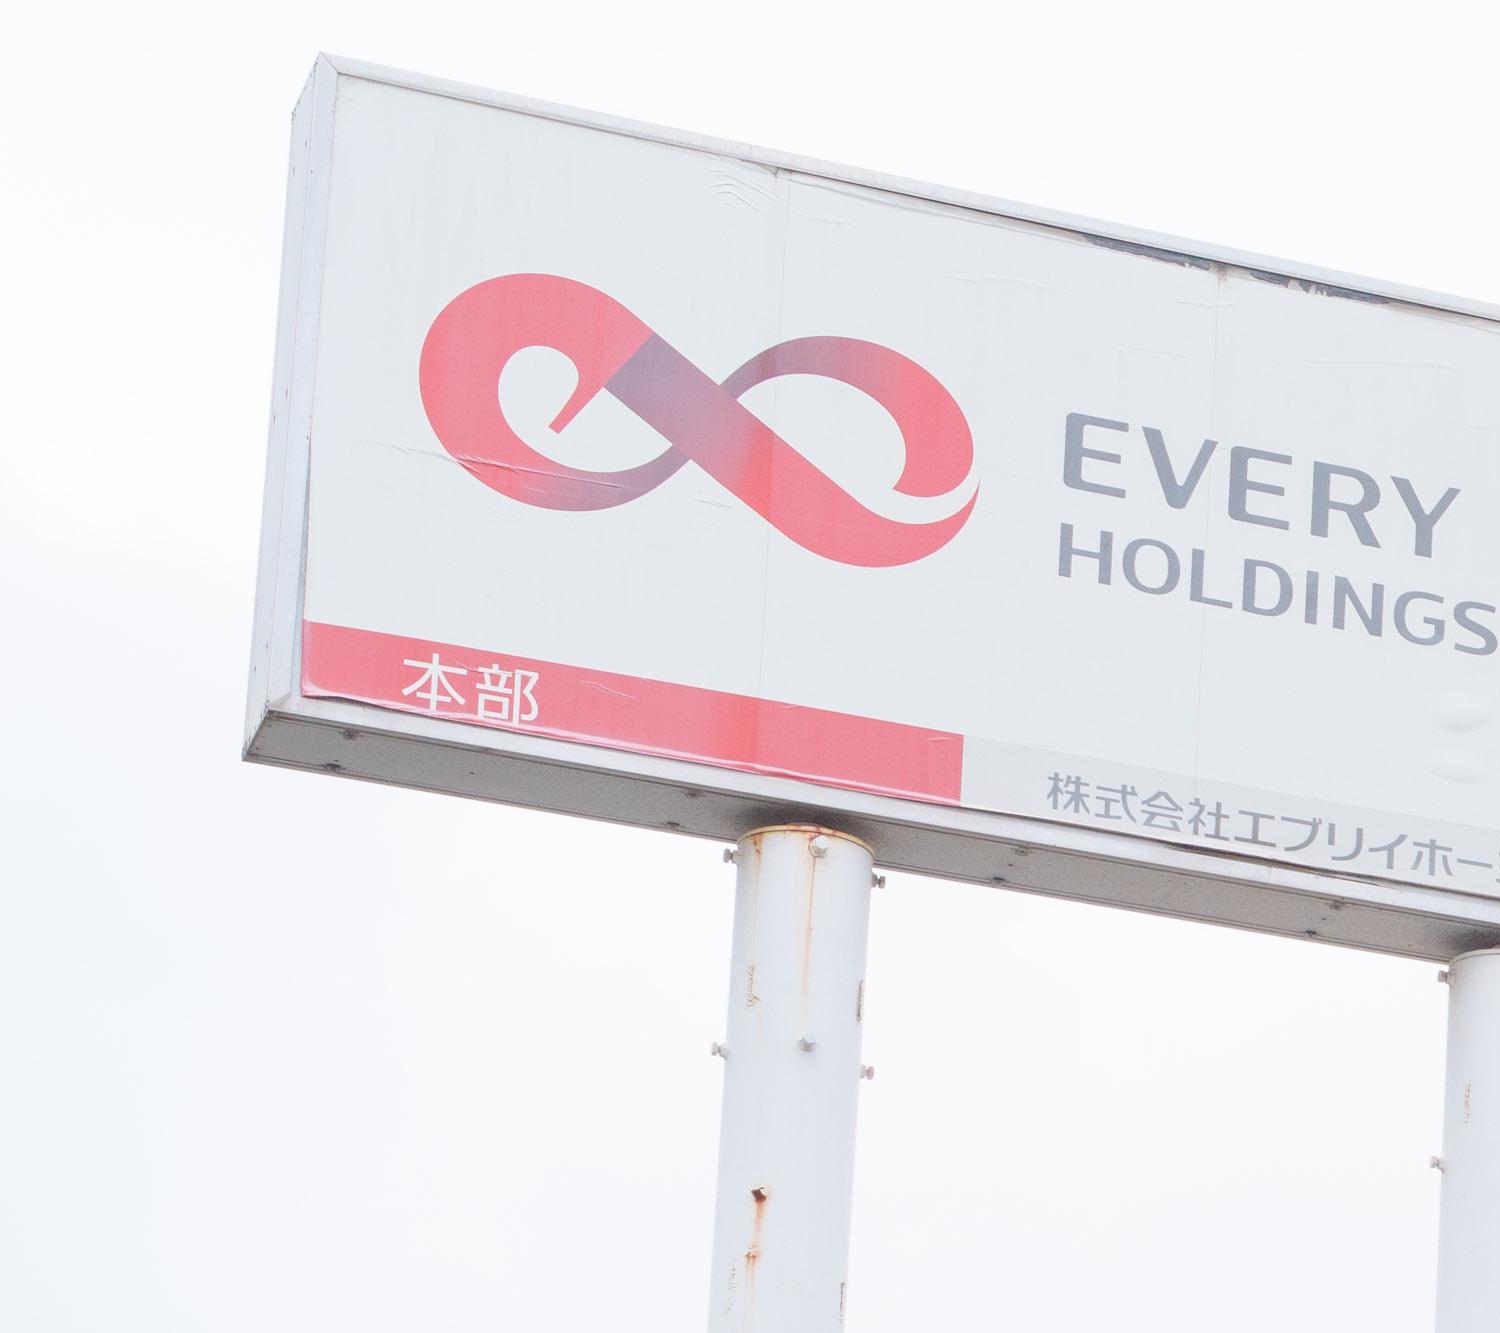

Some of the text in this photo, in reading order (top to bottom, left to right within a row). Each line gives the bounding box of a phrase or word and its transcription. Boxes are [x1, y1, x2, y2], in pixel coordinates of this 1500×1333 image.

[1063, 411, 1462, 559] EVERY
[1057, 521, 1499, 657] HOLDINGS
[400, 652, 540, 727] 本部
